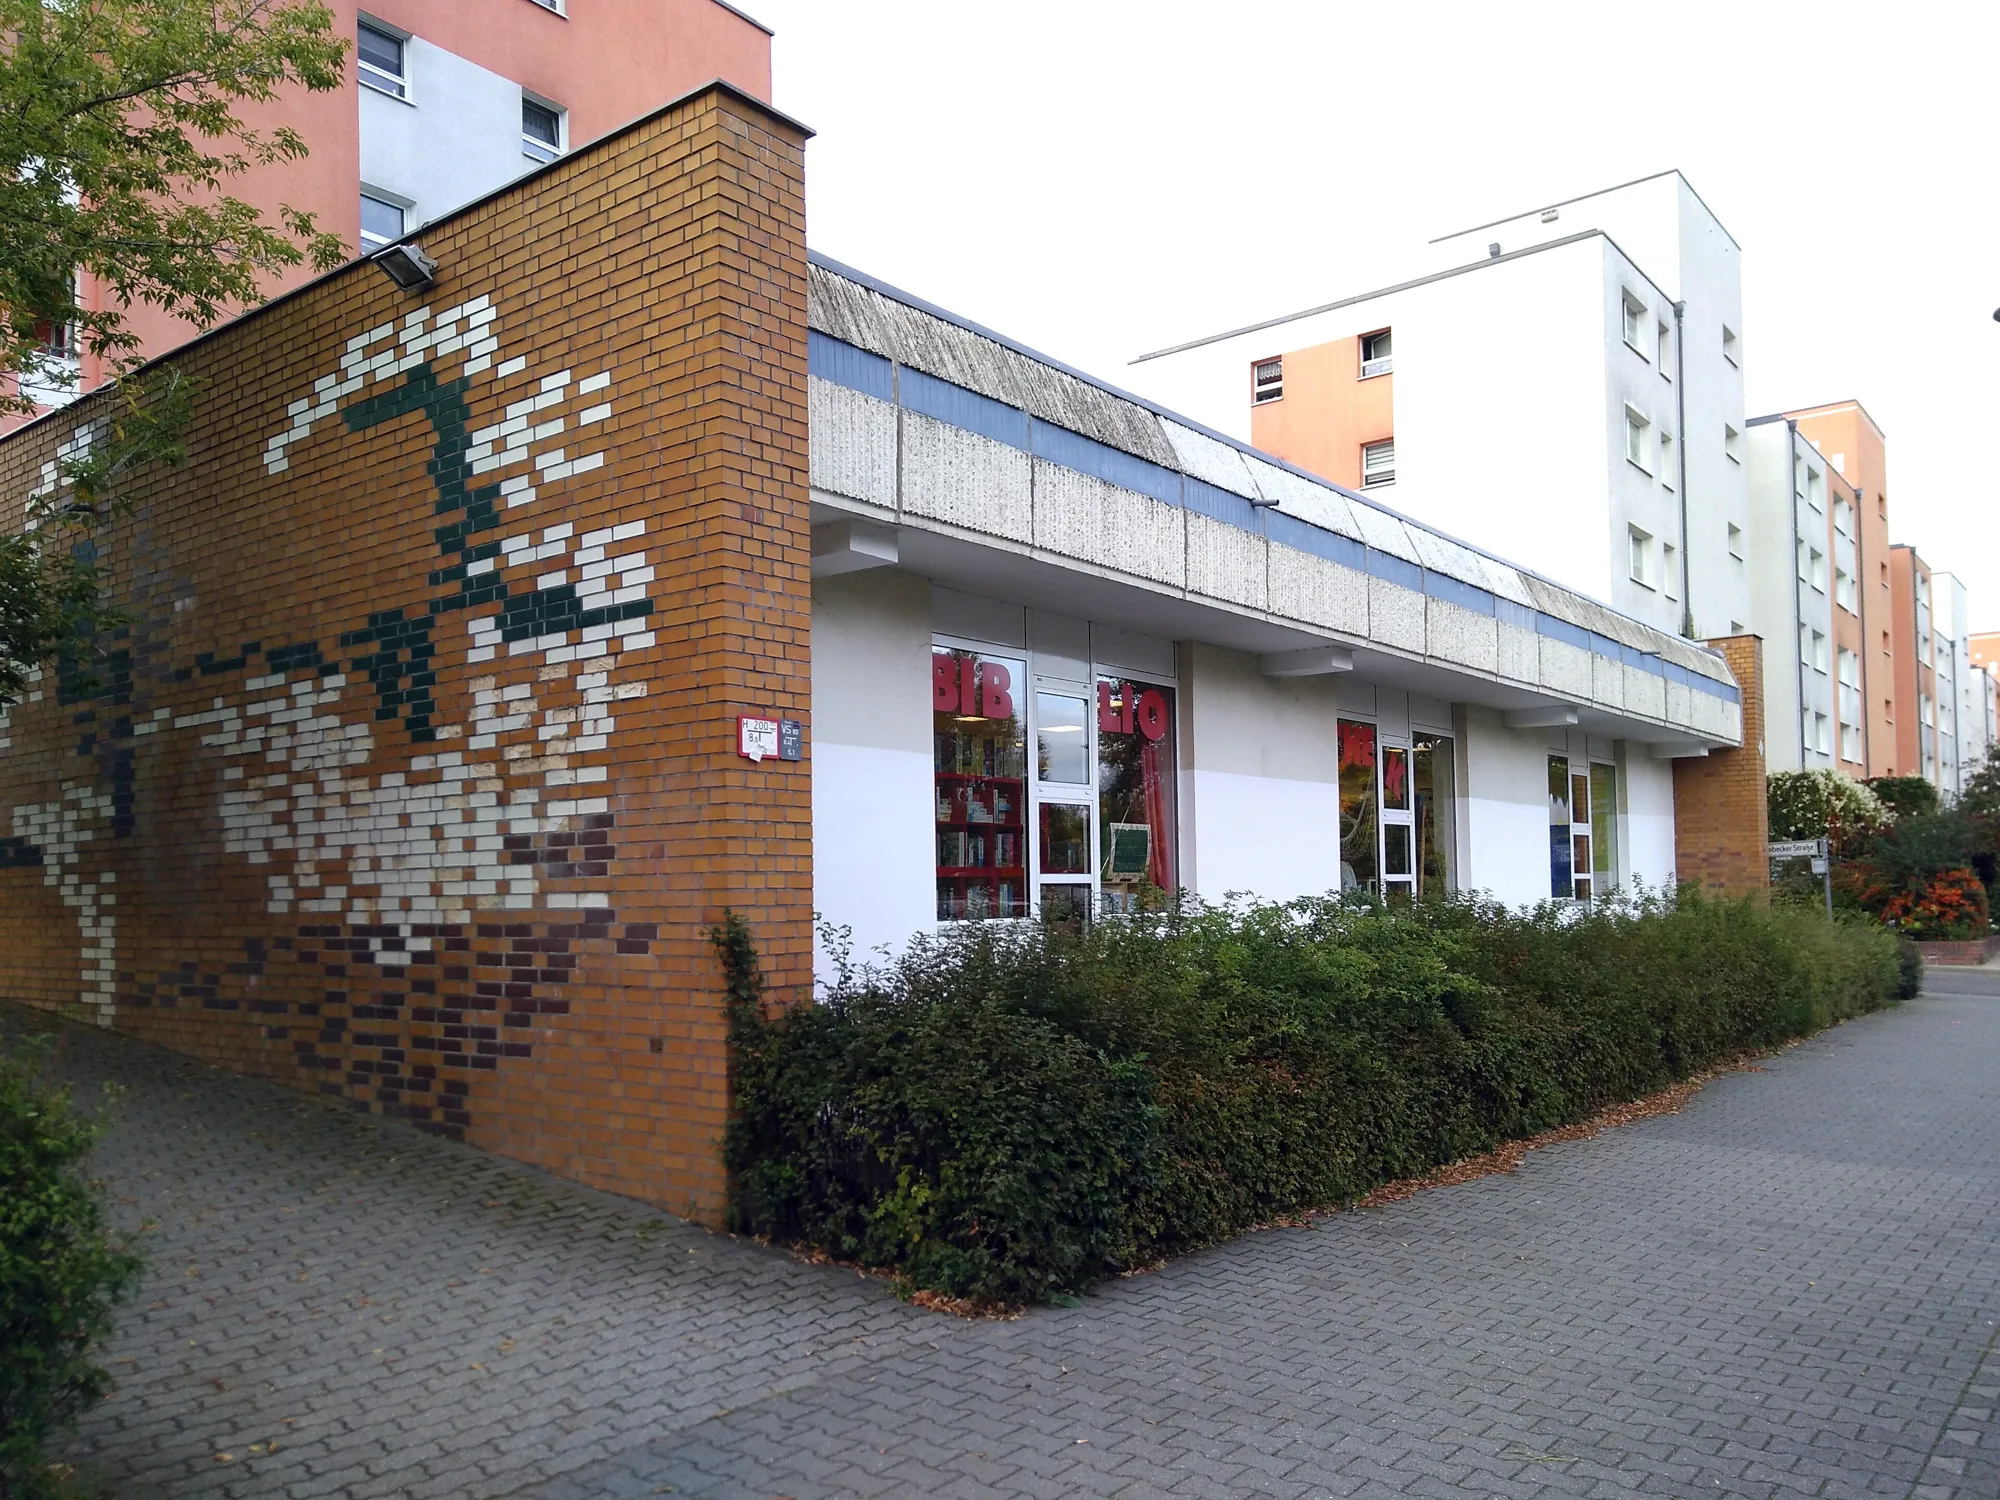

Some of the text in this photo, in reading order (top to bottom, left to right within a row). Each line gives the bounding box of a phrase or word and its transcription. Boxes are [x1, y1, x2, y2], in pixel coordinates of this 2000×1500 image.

[933, 653, 1013, 719] BIB
[743, 720, 748, 728] H
[754, 721, 768, 730] 200
[781, 724, 791, 734] VS
[1793, 844, 1814, 852] Straße
